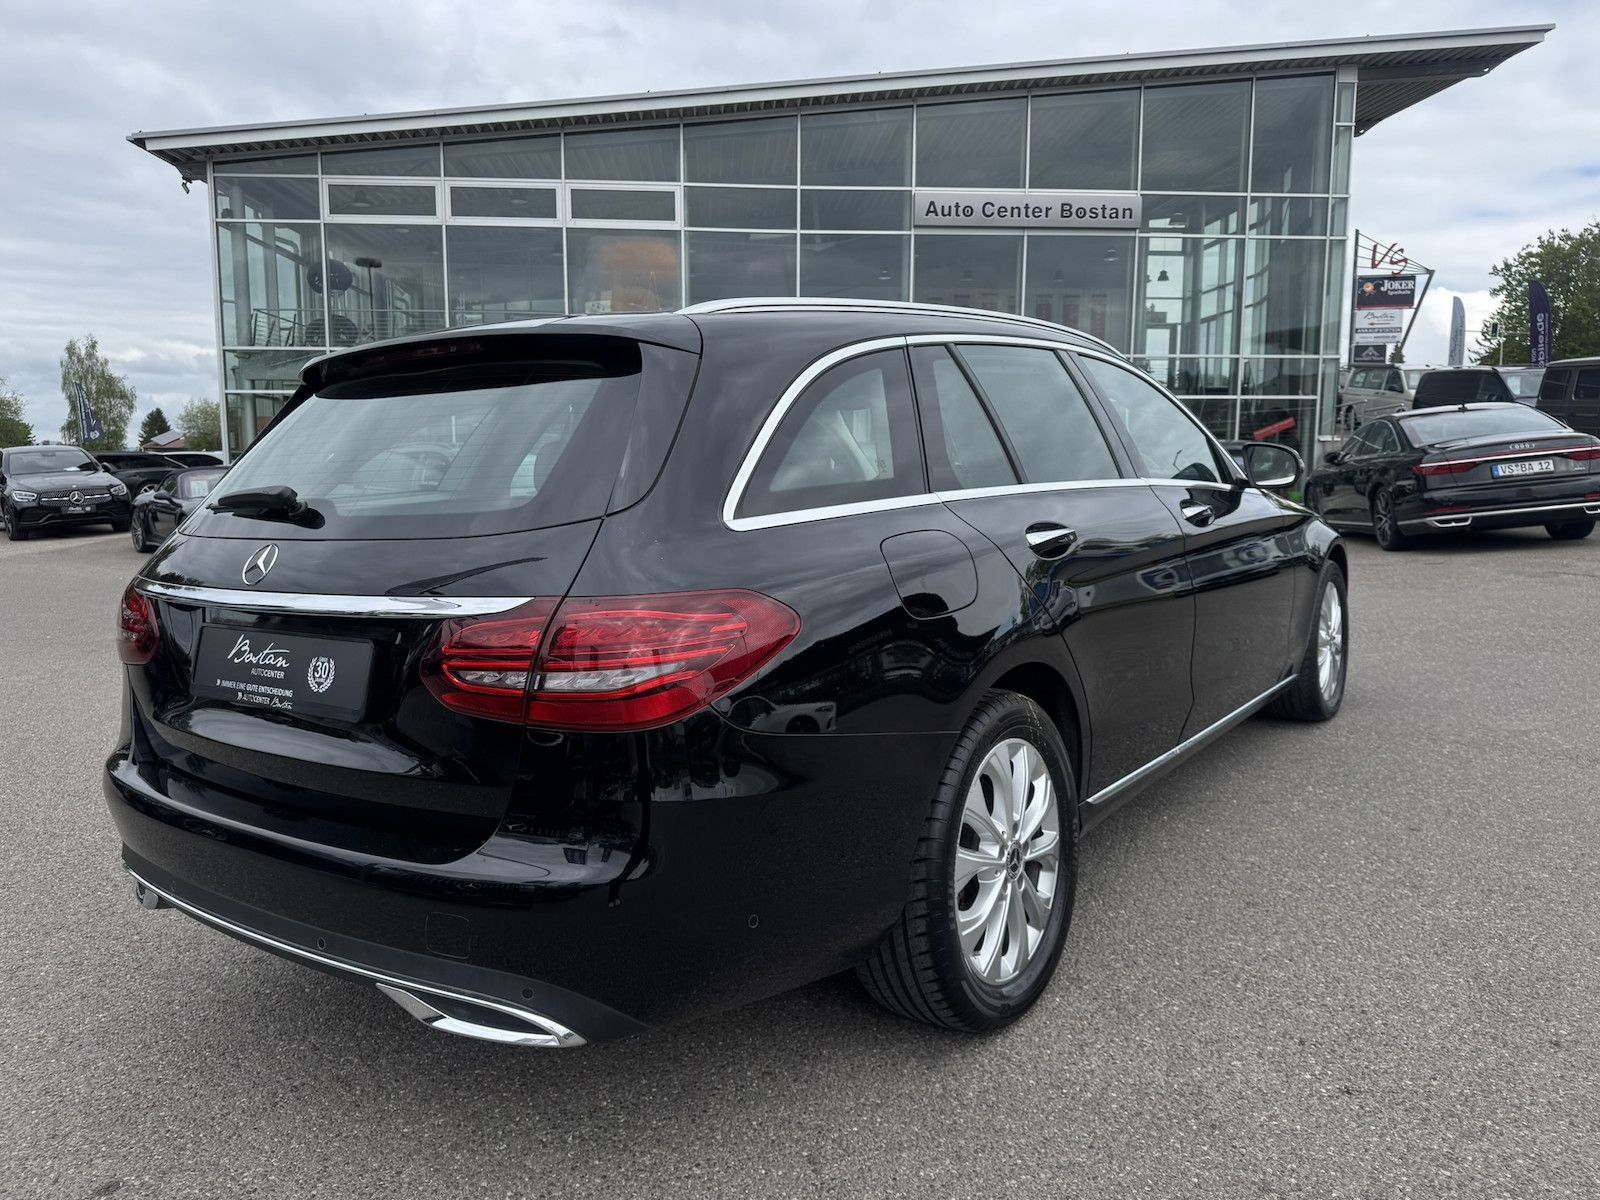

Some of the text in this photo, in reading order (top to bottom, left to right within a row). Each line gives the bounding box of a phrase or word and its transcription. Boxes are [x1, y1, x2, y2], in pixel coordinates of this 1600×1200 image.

[925, 201, 1133, 220] Auto Center Bostan
[1371, 243, 1408, 277] VS
[1380, 279, 1415, 292] JOKER
[1500, 461, 1551, 474] VS BA 12
[227, 633, 290, 668] Bostan
[251, 667, 285, 680] AUTOCENTER
[314, 661, 329, 678] 30
[246, 683, 259, 692] GUTE
[258, 685, 293, 697] ENTSCHEIDUNG
